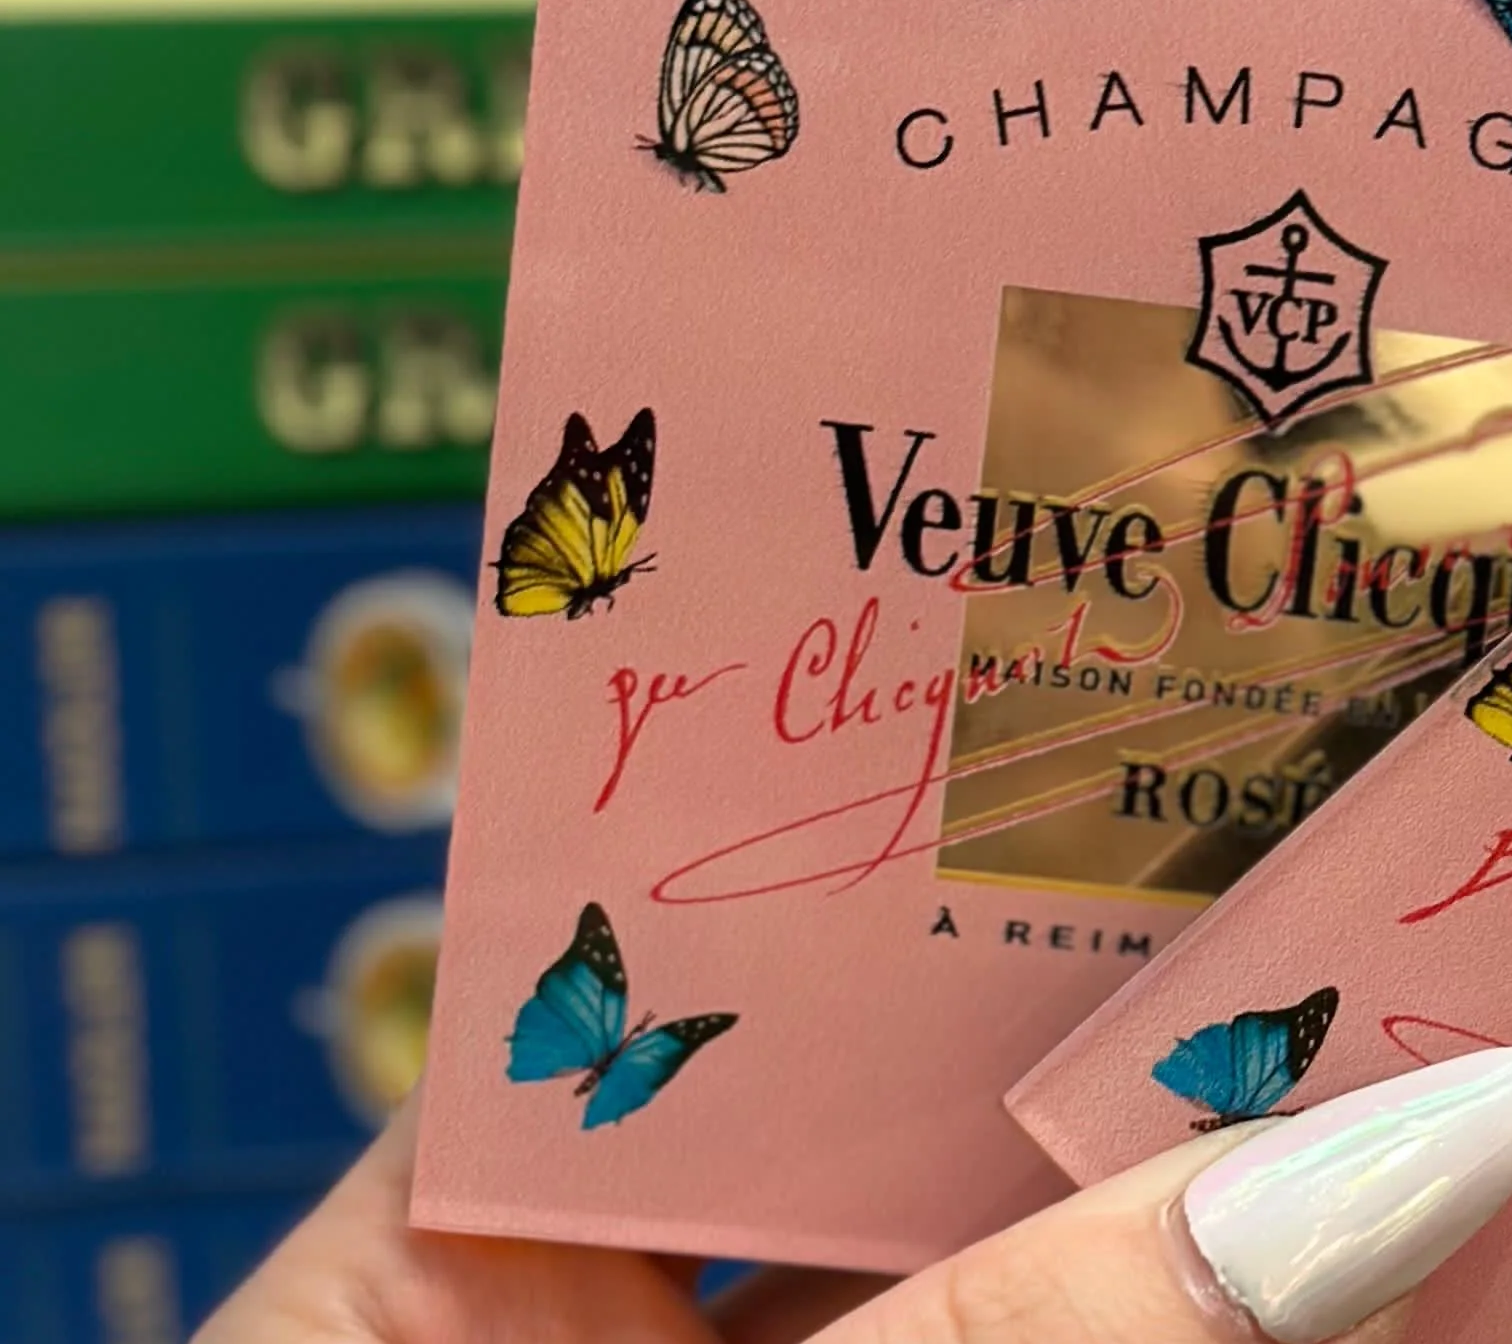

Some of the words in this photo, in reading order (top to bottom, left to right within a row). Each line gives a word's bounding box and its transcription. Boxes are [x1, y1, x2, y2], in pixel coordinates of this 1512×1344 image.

[1229, 288, 1339, 343] VCP
[820, 419, 1165, 600] Veuve
[970, 652, 1135, 697] MAISON
[1156, 672, 1324, 717] FONDÉE
[930, 906, 959, 939] À
